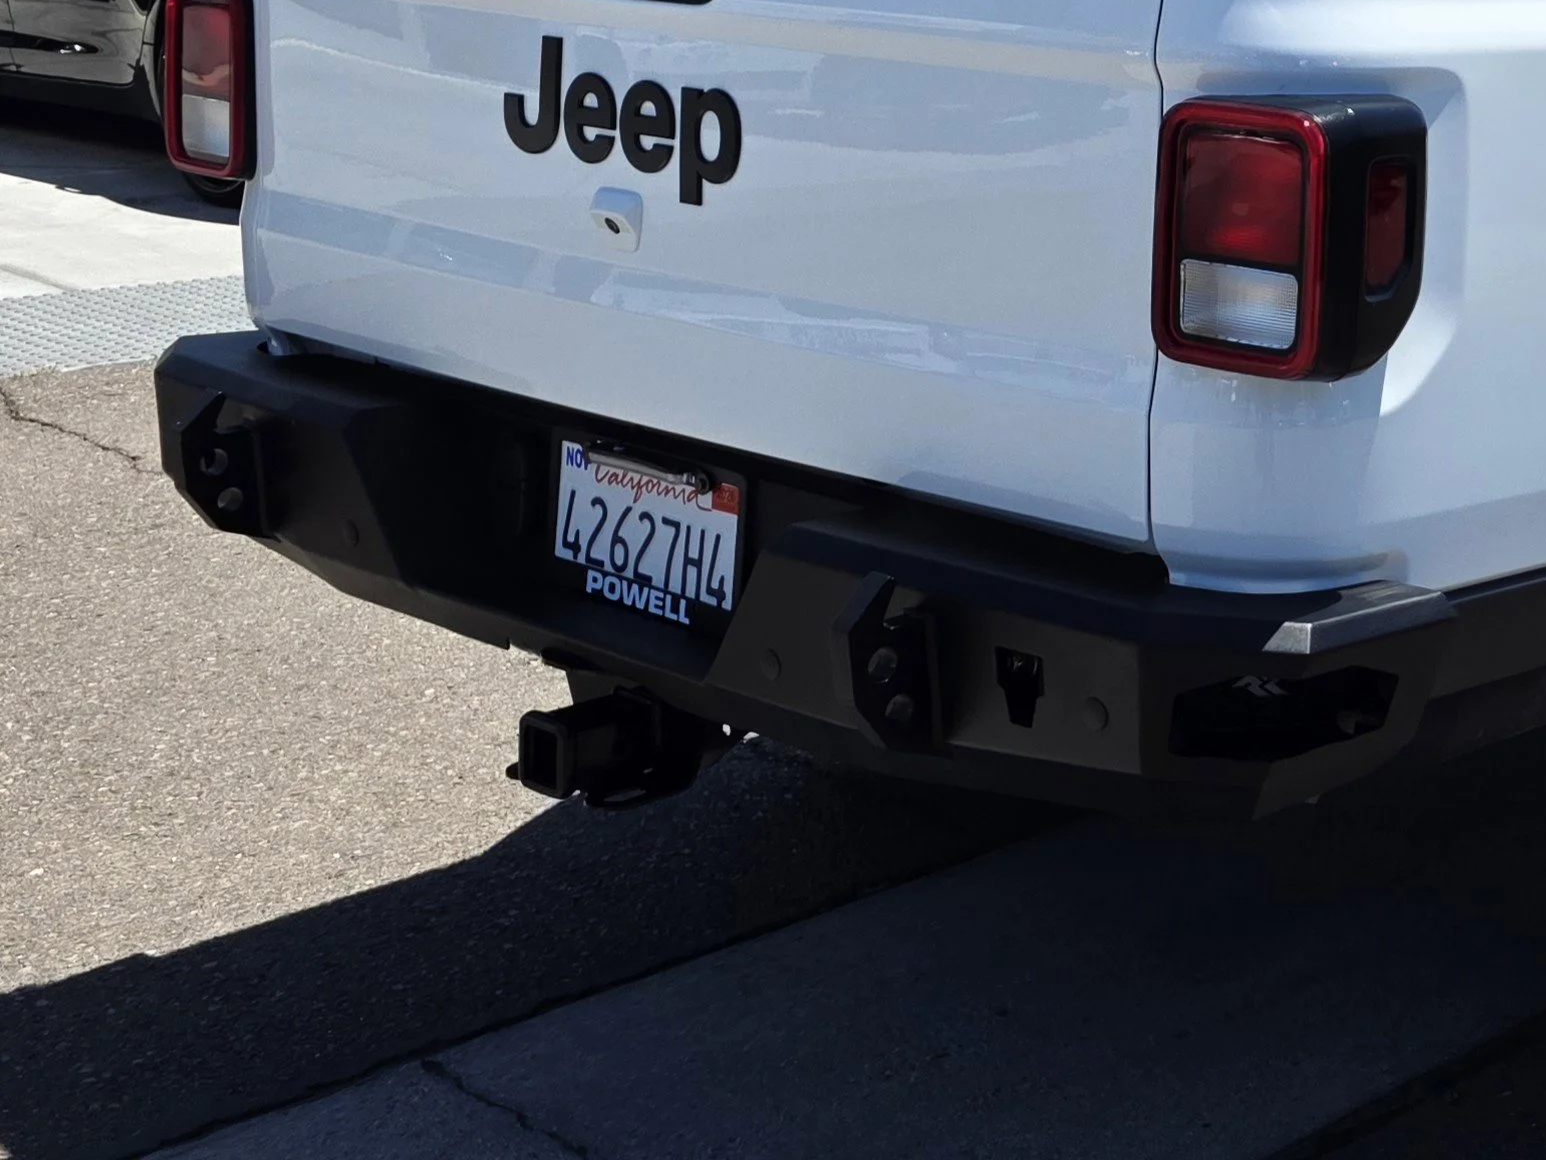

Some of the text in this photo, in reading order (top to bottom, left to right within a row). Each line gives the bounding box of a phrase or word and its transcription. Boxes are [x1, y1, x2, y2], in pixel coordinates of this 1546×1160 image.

[503, 34, 742, 207] Jeep
[594, 463, 708, 508] California
[561, 488, 727, 606] 42627H4
[585, 568, 690, 625] POWELL
